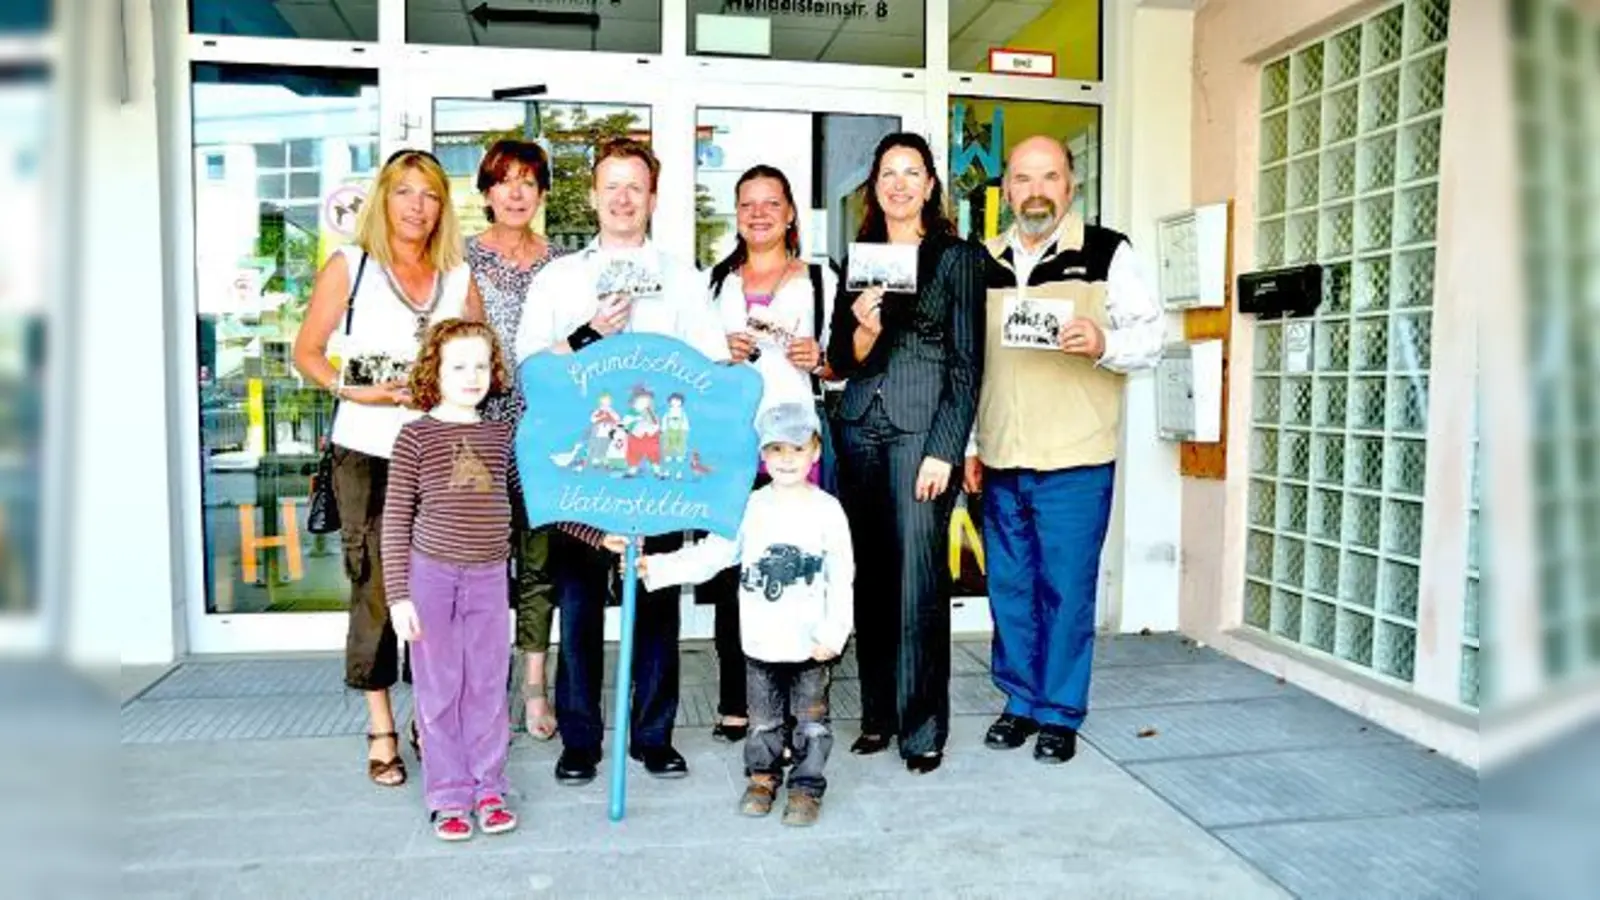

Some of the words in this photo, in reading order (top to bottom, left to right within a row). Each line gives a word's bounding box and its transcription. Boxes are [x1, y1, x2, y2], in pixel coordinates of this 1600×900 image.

[876, 0, 889, 18] 8
[567, 346, 713, 397] Grundschule
[558, 484, 711, 519] Vaterstetten
